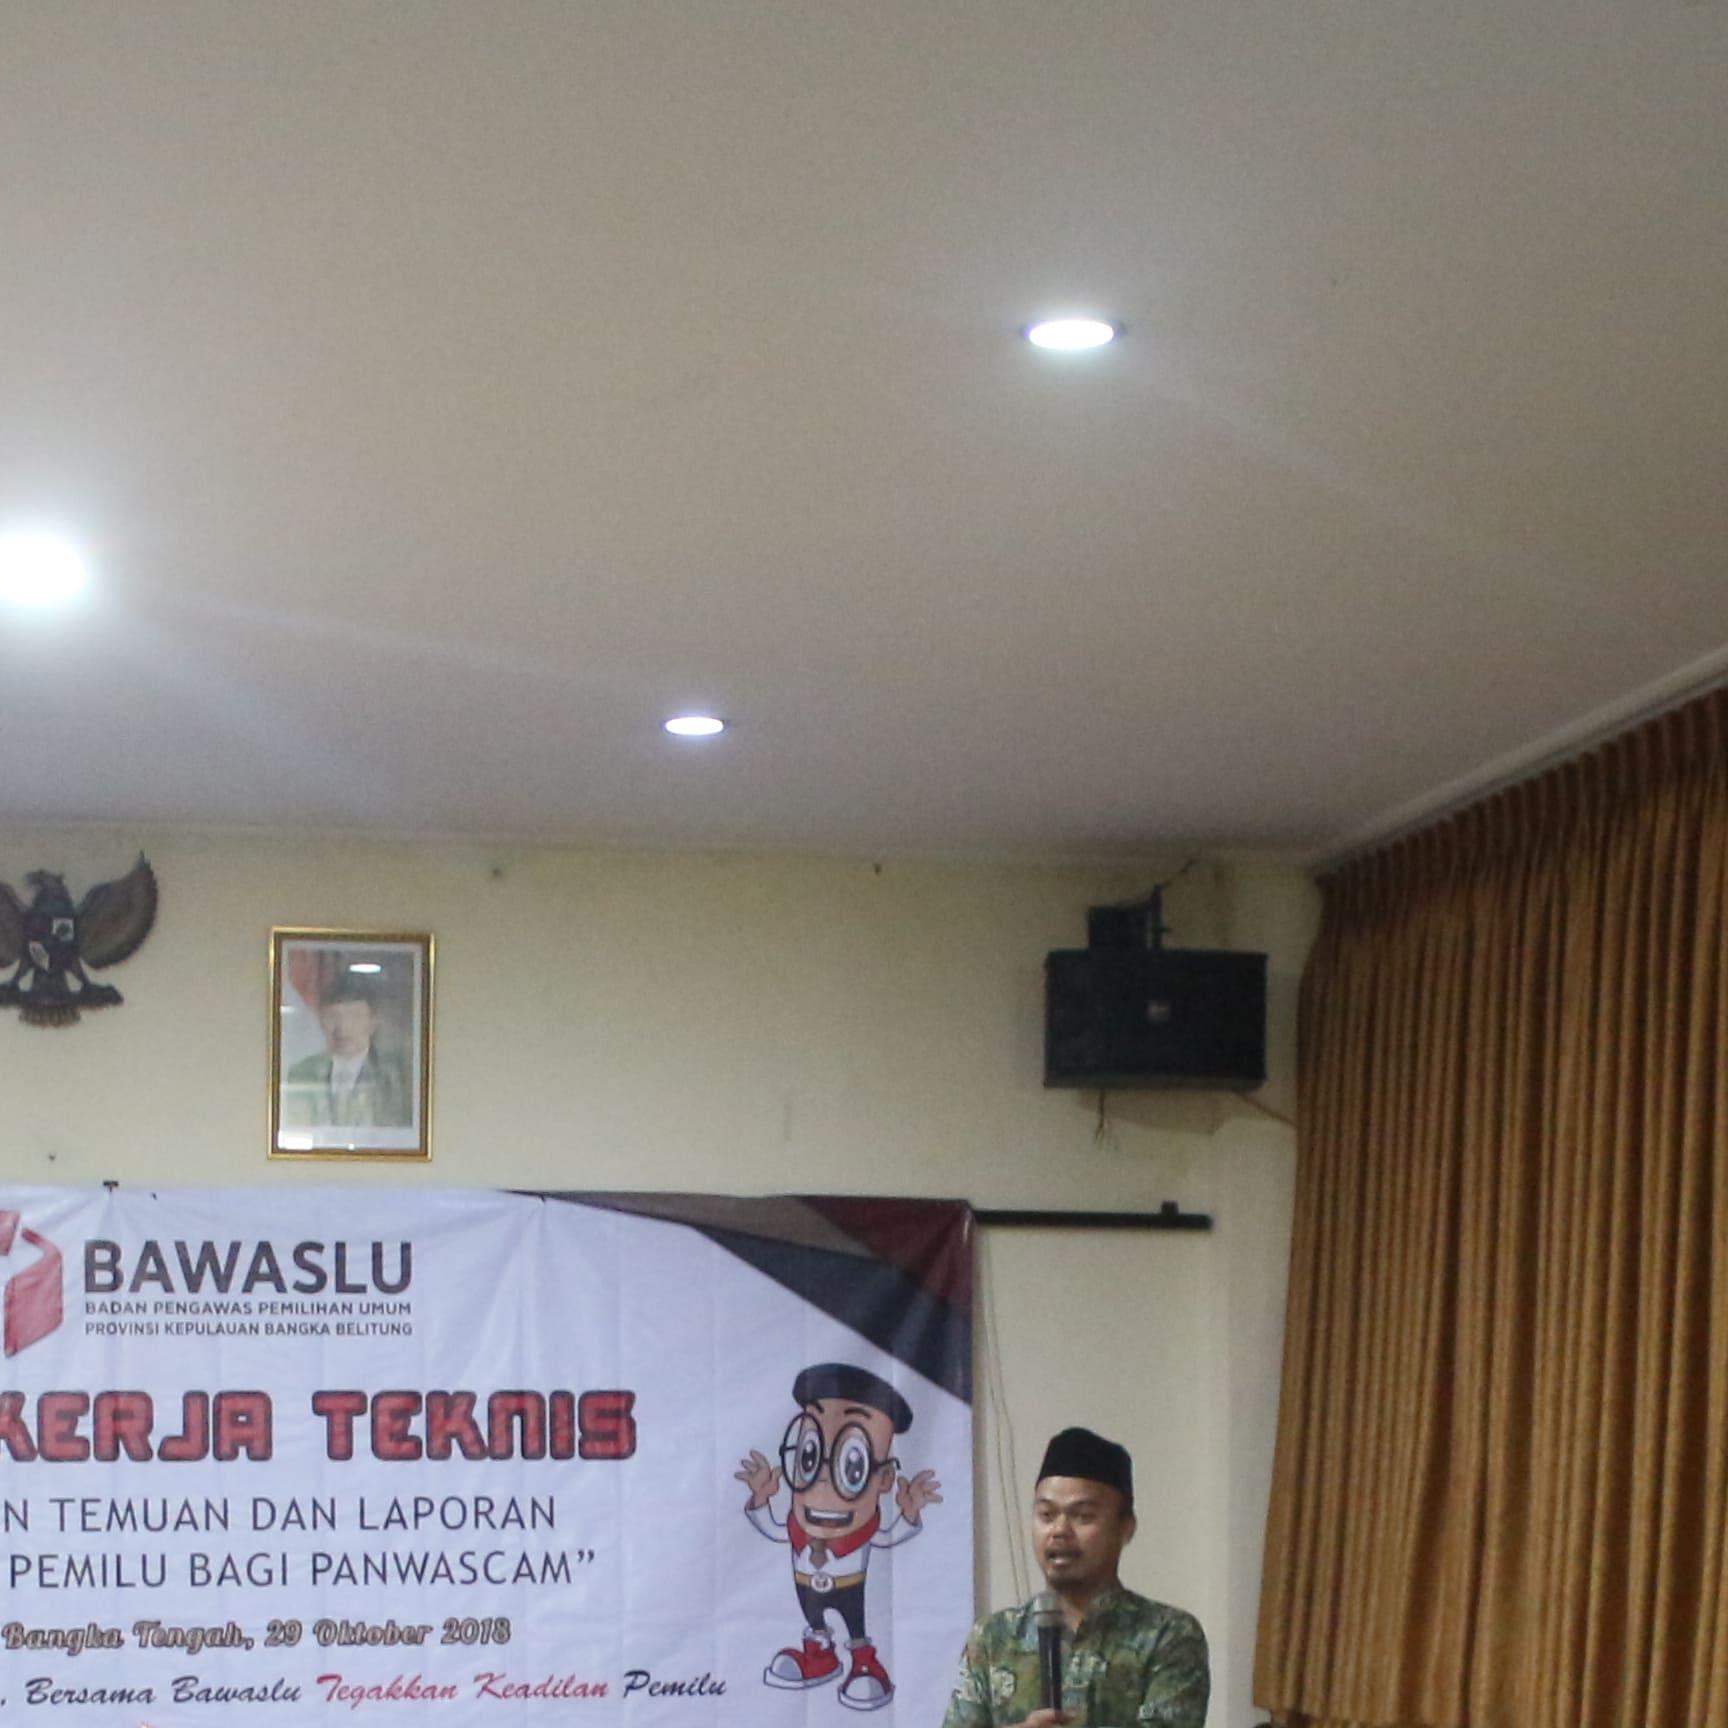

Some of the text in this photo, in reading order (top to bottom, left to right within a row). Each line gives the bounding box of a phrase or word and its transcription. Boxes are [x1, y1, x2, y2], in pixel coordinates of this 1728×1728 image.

[84, 1238, 413, 1295] BAWASLU
[85, 1301, 412, 1316] BADAN PENGAWAS PEMILIHAN UMUM
[85, 1322, 413, 1336] PROVINSI KEPULAUAN BANGKA BELITUNG
[311, 1389, 637, 1462] TEKNIS
[49, 1496, 230, 1533] TEMUAN
[251, 1496, 337, 1531] DAN
[359, 1495, 556, 1531] LAPORAN
[9, 1553, 167, 1589] PEMILU
[189, 1552, 288, 1587] BAGI
[310, 1550, 596, 1586] PANWASCAM”
[1, 1620, 125, 1656] Bangka
[131, 1619, 255, 1655] Tengah,
[263, 1619, 303, 1648] 29
[312, 1617, 434, 1646] Oktober
[440, 1617, 512, 1646] 2018
[23, 1676, 157, 1705] Bersama
[171, 1675, 303, 1703] Bawaslu
[315, 1673, 459, 1711] Tegakkan
[473, 1671, 610, 1700] Keadilan
[621, 1669, 727, 1699] Pemilu
